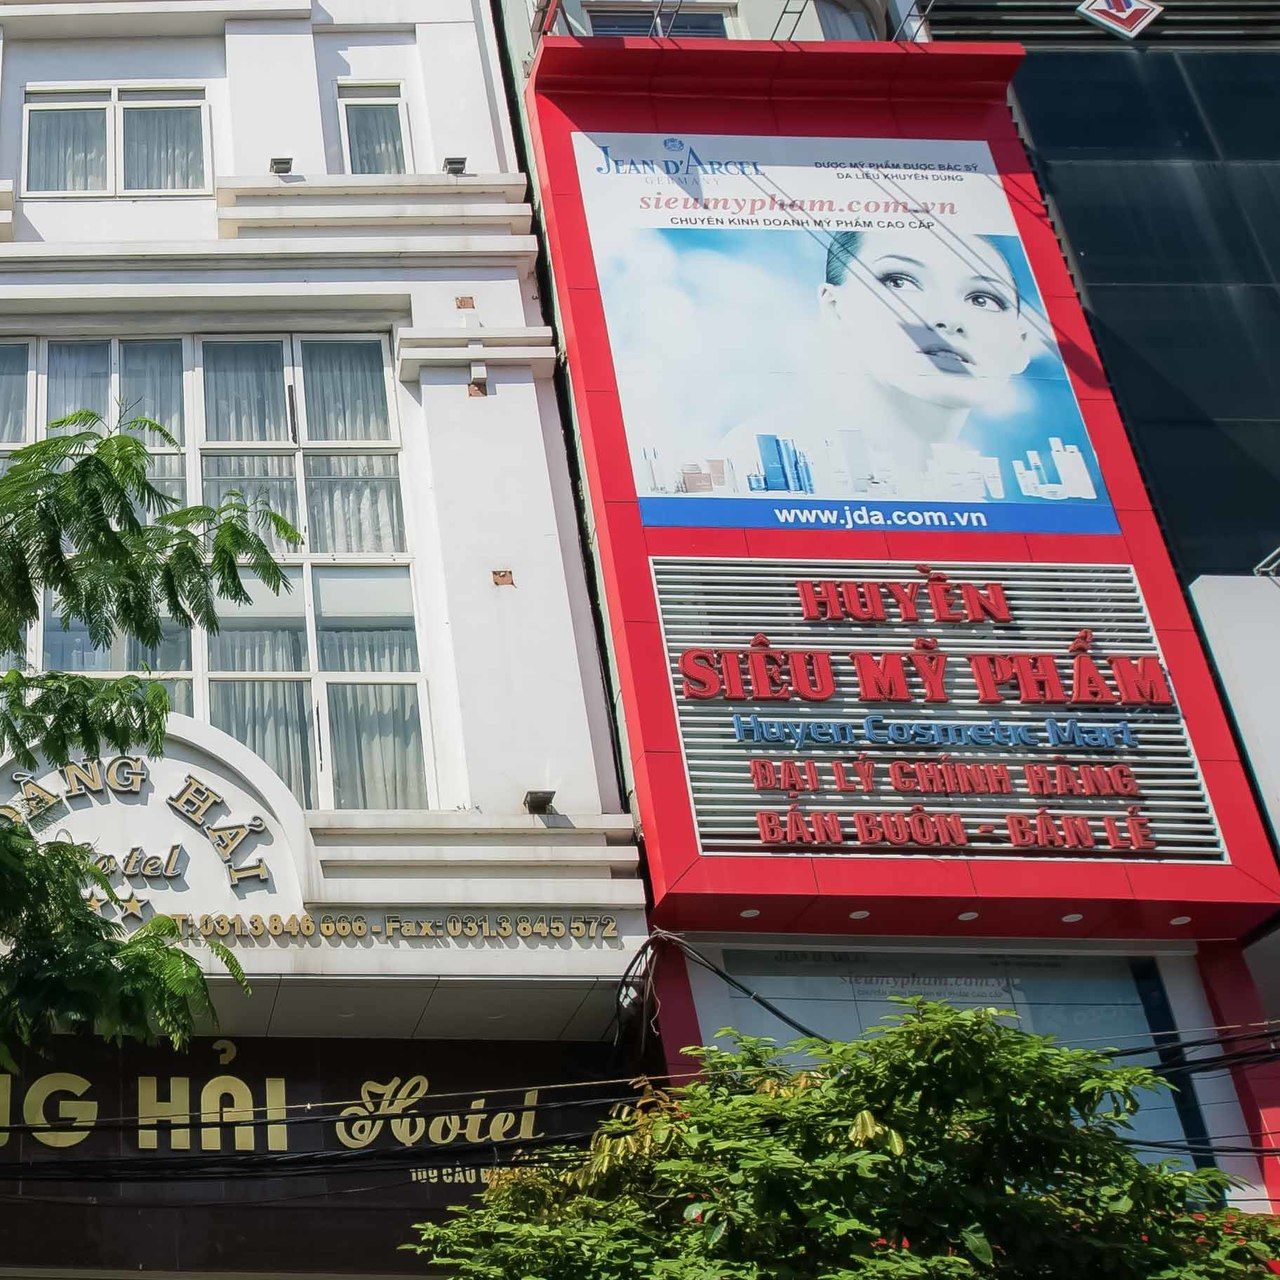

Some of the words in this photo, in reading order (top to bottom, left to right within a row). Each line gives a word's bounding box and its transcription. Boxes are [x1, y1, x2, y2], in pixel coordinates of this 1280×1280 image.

[837, 172, 853, 180] DA
[639, 191, 959, 216] sieumypham.com.vn
[728, 218, 760, 226] KINH
[763, 219, 810, 227] DOANH
[877, 220, 906, 229] CAO
[774, 506, 987, 529] www.jda.com.vn
[677, 632, 837, 701] SIÊU
[849, 636, 950, 703] MỸ
[967, 629, 1173, 706] PHẨM
[732, 713, 855, 750] Huyen
[863, 714, 1040, 747] Cosmetic
[1045, 718, 1139, 748] Mart
[750, 759, 820, 799] ĐẠI
[832, 752, 876, 793] LÝ
[888, 753, 1013, 795] CHÍNH
[854, 804, 968, 847] BUÔN
[386, 914, 445, 937] Fax:
[570, 914, 617, 938] 572
[137, 1039, 289, 1151] HẢI
[335, 1074, 546, 1149] Hotel
